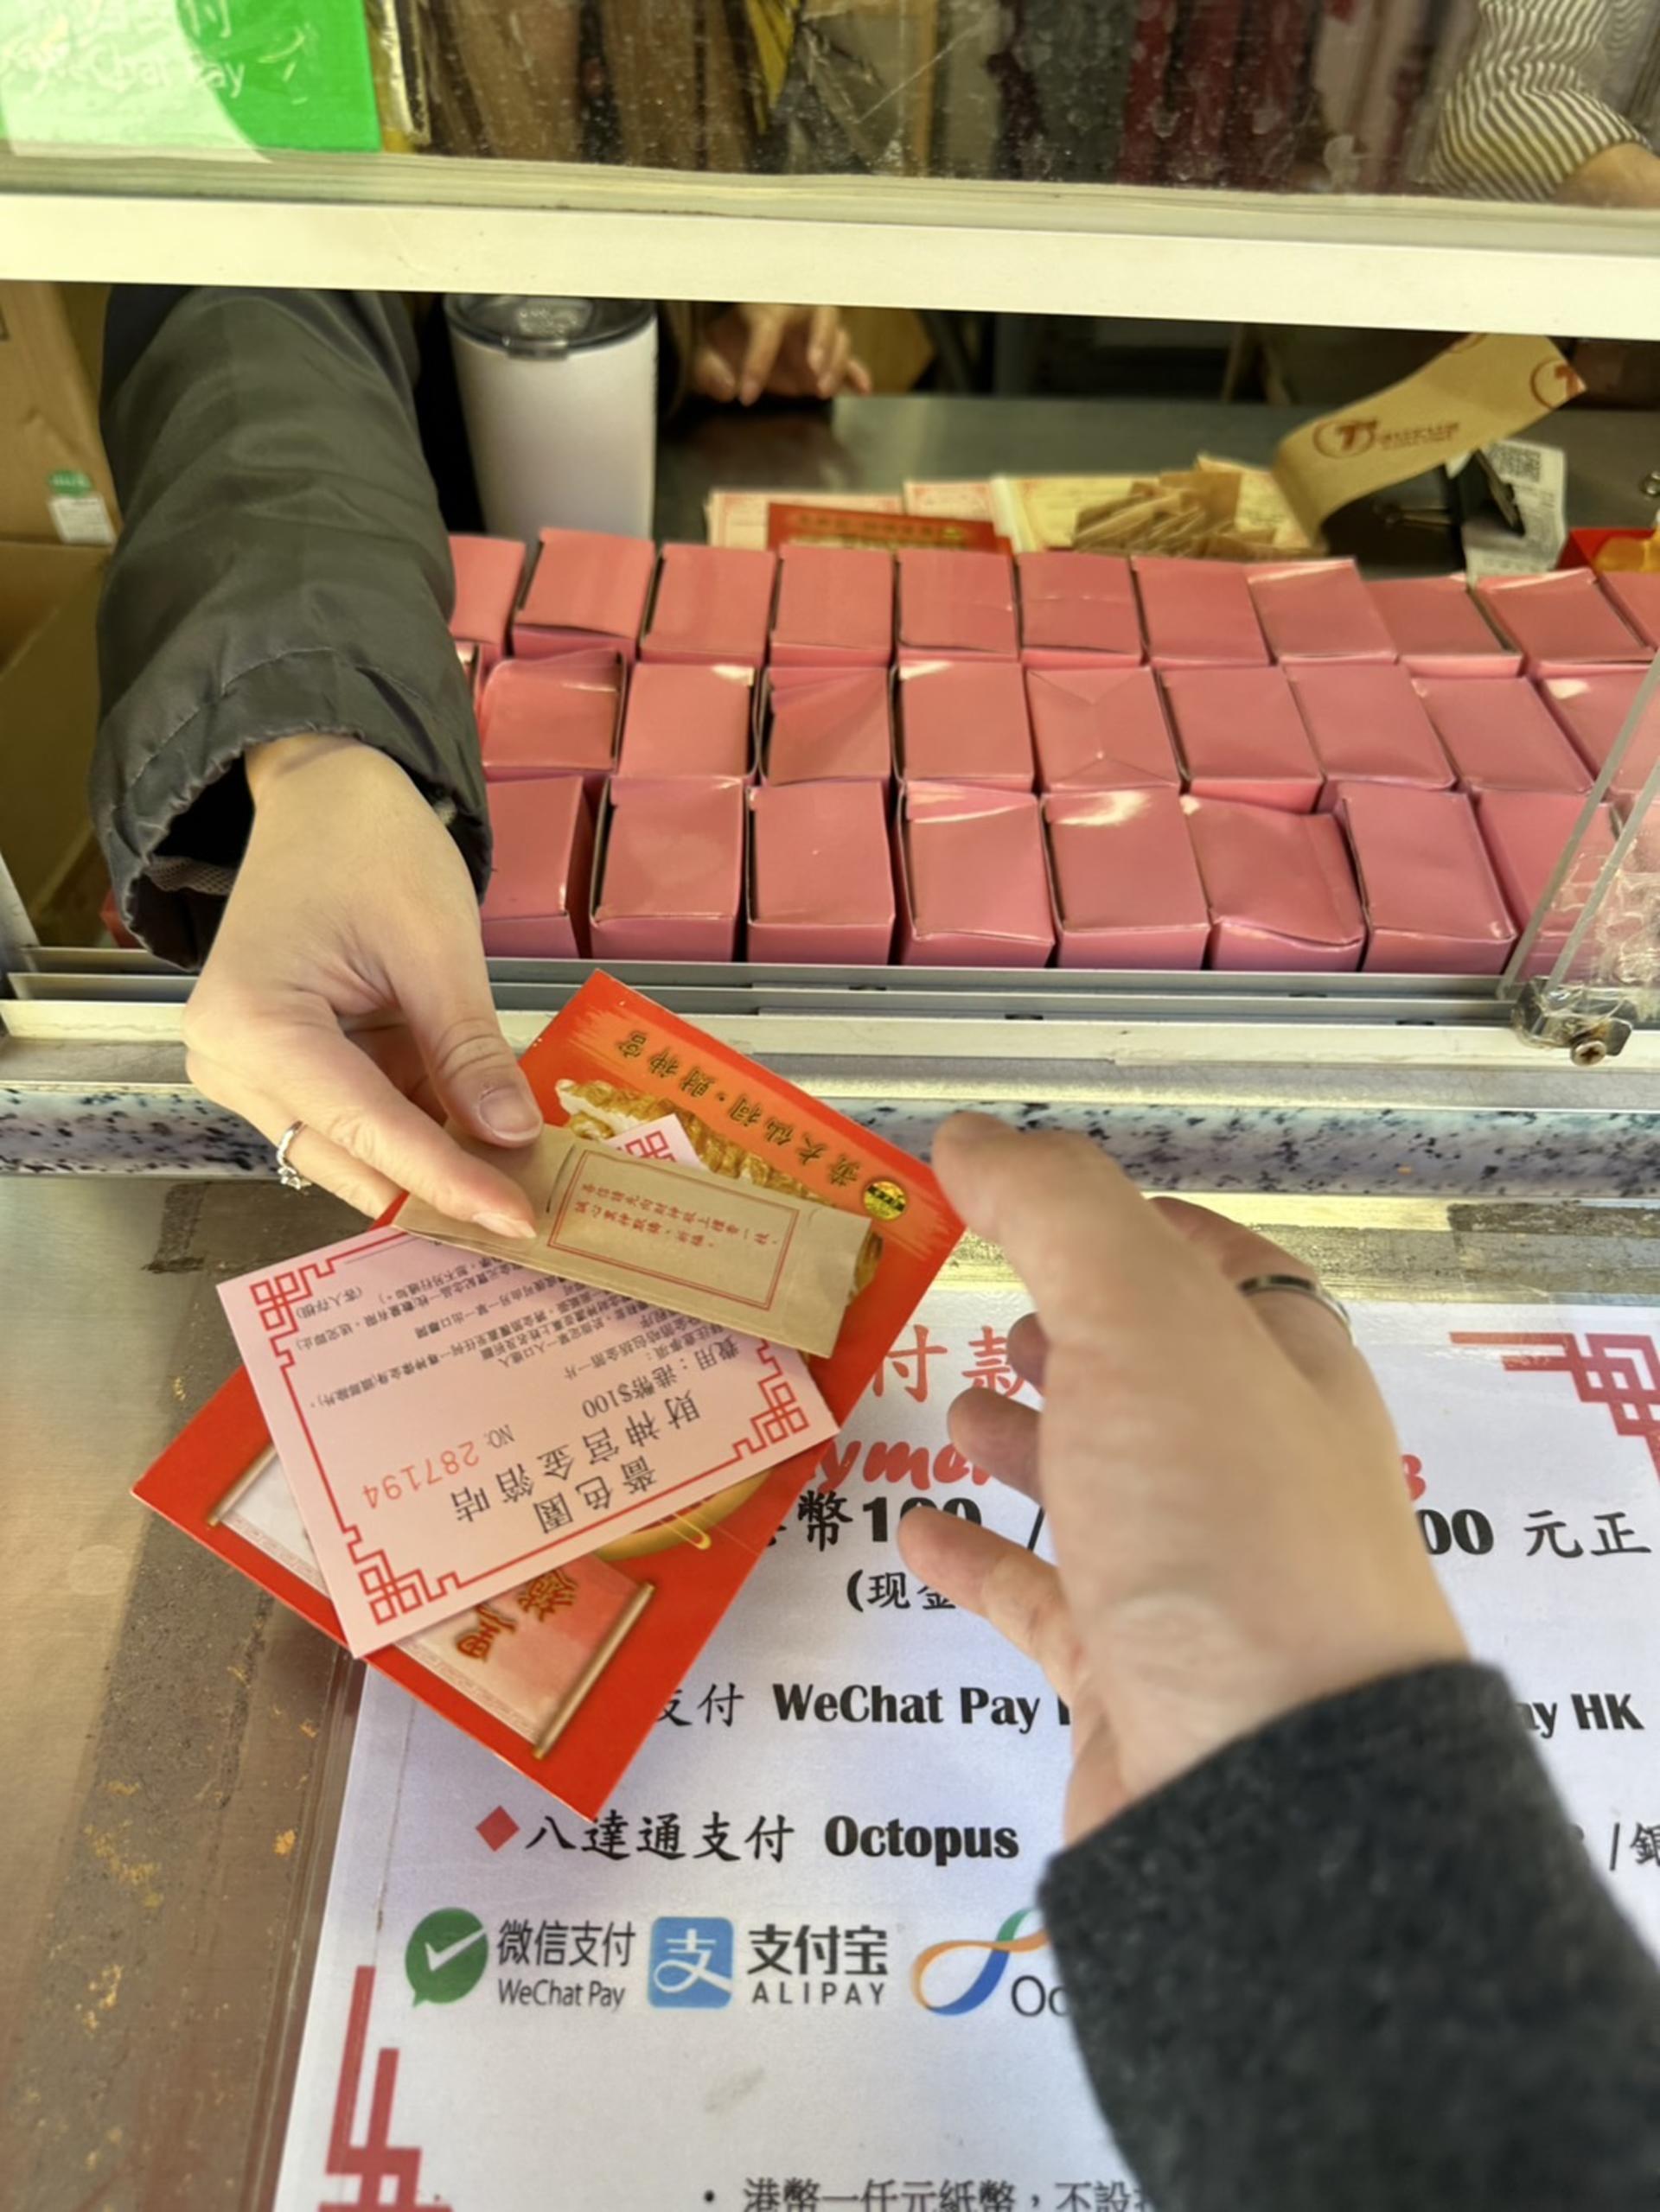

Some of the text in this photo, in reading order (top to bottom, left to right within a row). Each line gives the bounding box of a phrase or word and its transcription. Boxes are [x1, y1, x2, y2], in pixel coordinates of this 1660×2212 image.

[359, 1437, 482, 1511] 287194
[444, 1386, 702, 1526] 財神宮金箔咭
[528, 1450, 662, 1537] 嗇色園
[1523, 1509, 1652, 1559] 元正
[772, 1683, 944, 1724] WeChat
[960, 1686, 1041, 1735] Pay
[1570, 1692, 1646, 1731] HK
[525, 1808, 795, 1863] 八達通支付
[825, 1814, 1020, 1867] Octopus
[496, 1918, 636, 1968] 微信支付
[747, 1923, 889, 1976] 支付宝
[498, 1978, 626, 2013] WeChat Pay
[751, 1981, 886, 2005] ALIPAY
